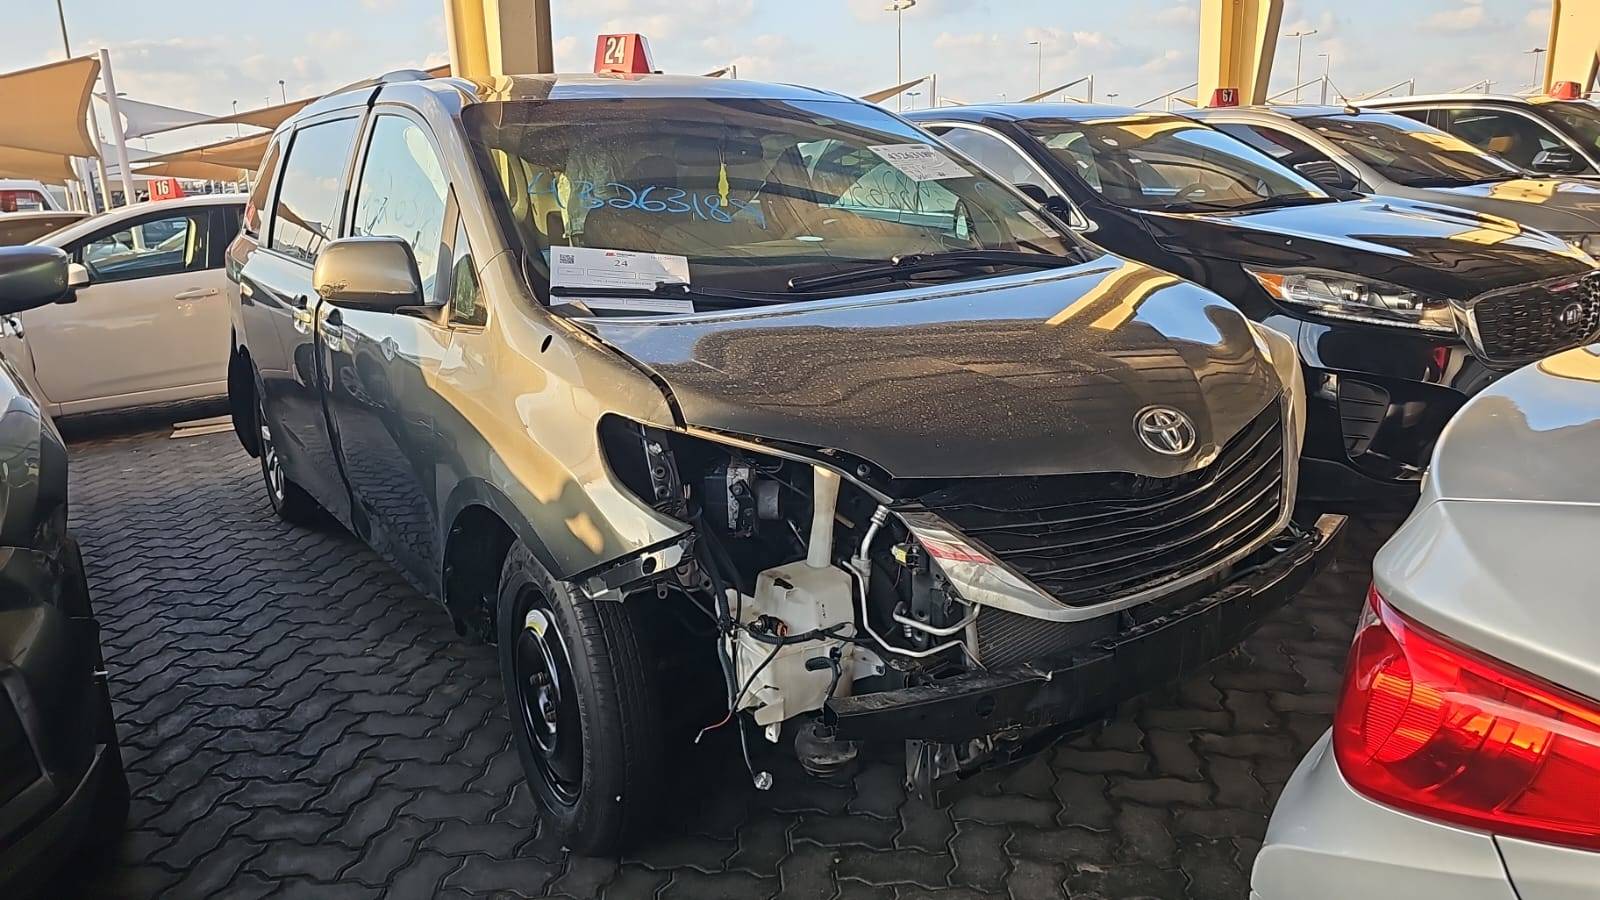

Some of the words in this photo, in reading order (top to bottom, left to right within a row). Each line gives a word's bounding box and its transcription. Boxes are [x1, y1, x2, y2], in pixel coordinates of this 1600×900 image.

[604, 36, 626, 64] 24
[1222, 89, 1233, 102] 67
[156, 180, 169, 195] 16
[614, 259, 628, 267] 24
